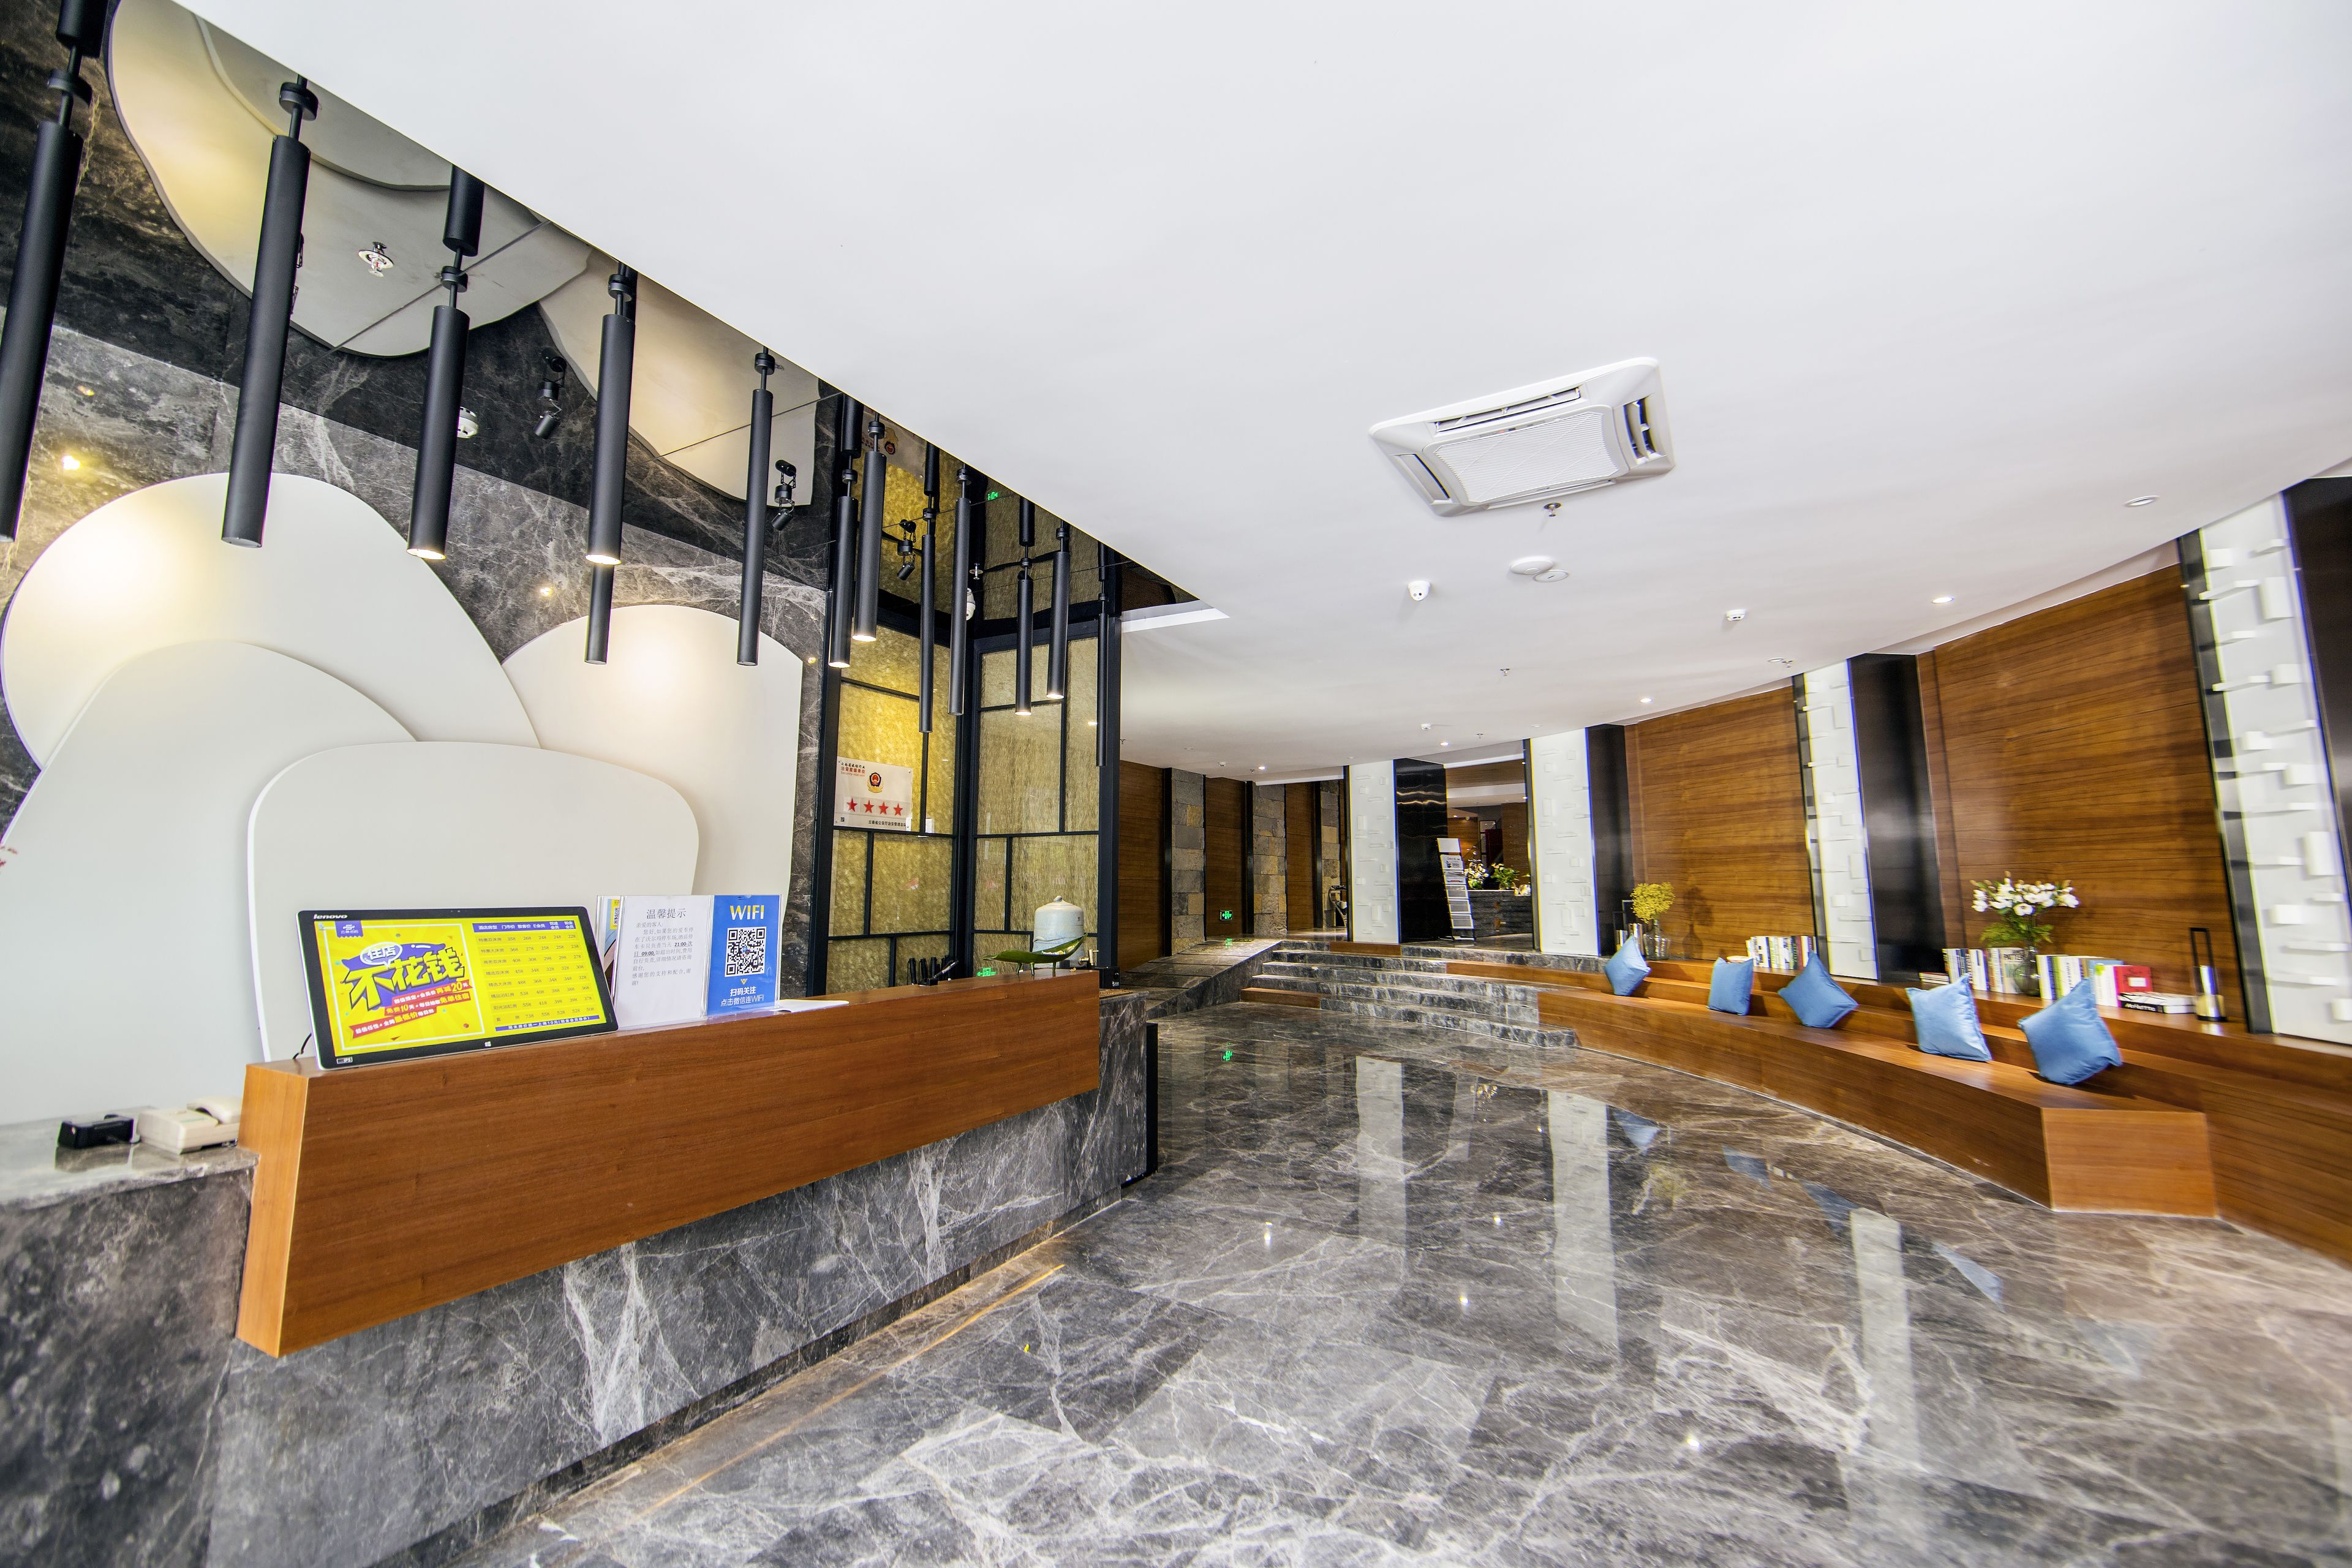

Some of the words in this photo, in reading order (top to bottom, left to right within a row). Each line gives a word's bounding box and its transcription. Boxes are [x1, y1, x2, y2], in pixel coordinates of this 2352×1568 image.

[646, 908, 686, 919] 温馨提示
[729, 905, 764, 921] WIFI
[367, 946, 397, 960] 住店
[343, 947, 466, 1011] 不花钱
[729, 986, 756, 997] 扫码关注
[720, 994, 764, 1007] 点击微信连WIFI
